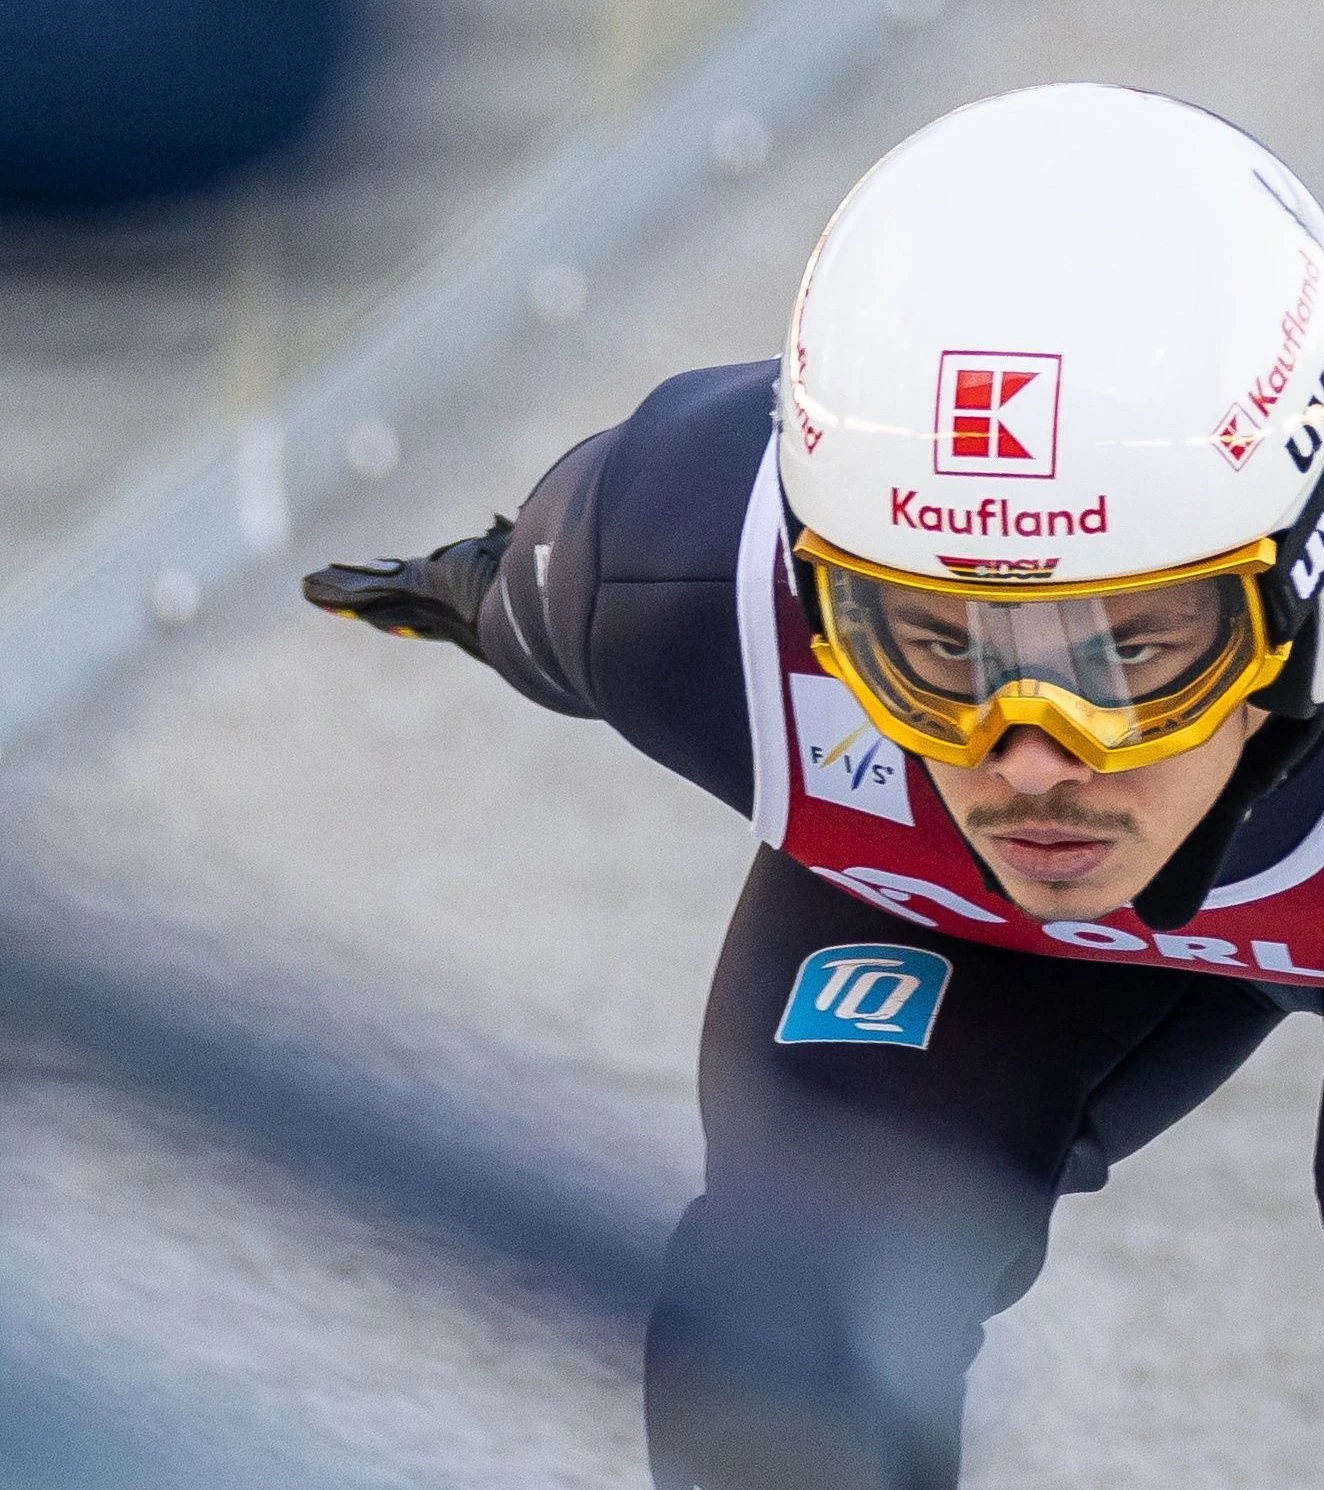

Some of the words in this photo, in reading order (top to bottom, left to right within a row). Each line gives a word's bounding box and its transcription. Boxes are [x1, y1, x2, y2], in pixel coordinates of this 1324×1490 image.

[1248, 248, 1320, 418] Kaufland
[891, 487, 1108, 537] Kaufland
[820, 958, 922, 1032] TQ
